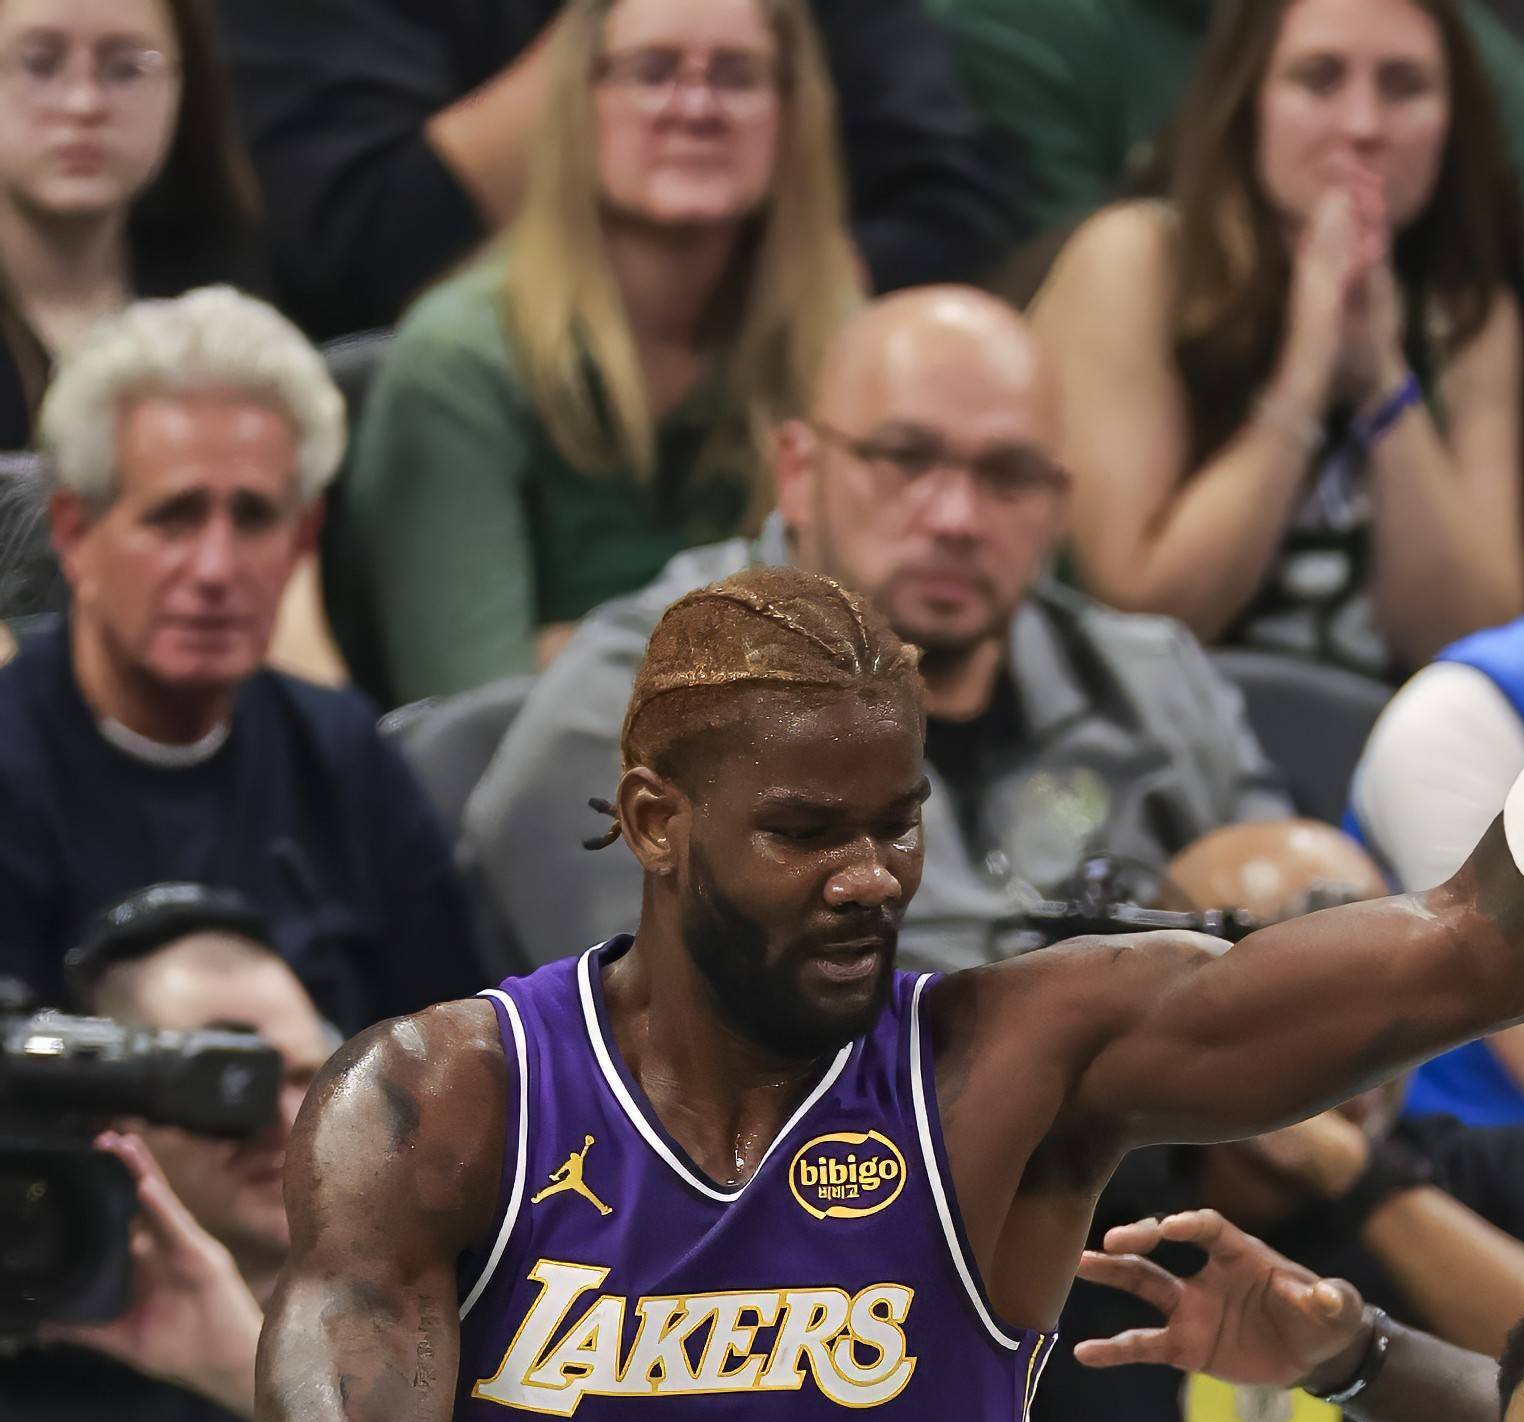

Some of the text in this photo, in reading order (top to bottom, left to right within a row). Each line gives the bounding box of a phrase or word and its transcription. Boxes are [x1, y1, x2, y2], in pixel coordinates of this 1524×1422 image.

[800, 1153, 899, 1191] bibigo
[818, 1184, 860, 1200] 비비고
[471, 1258, 918, 1419] LAKERS
